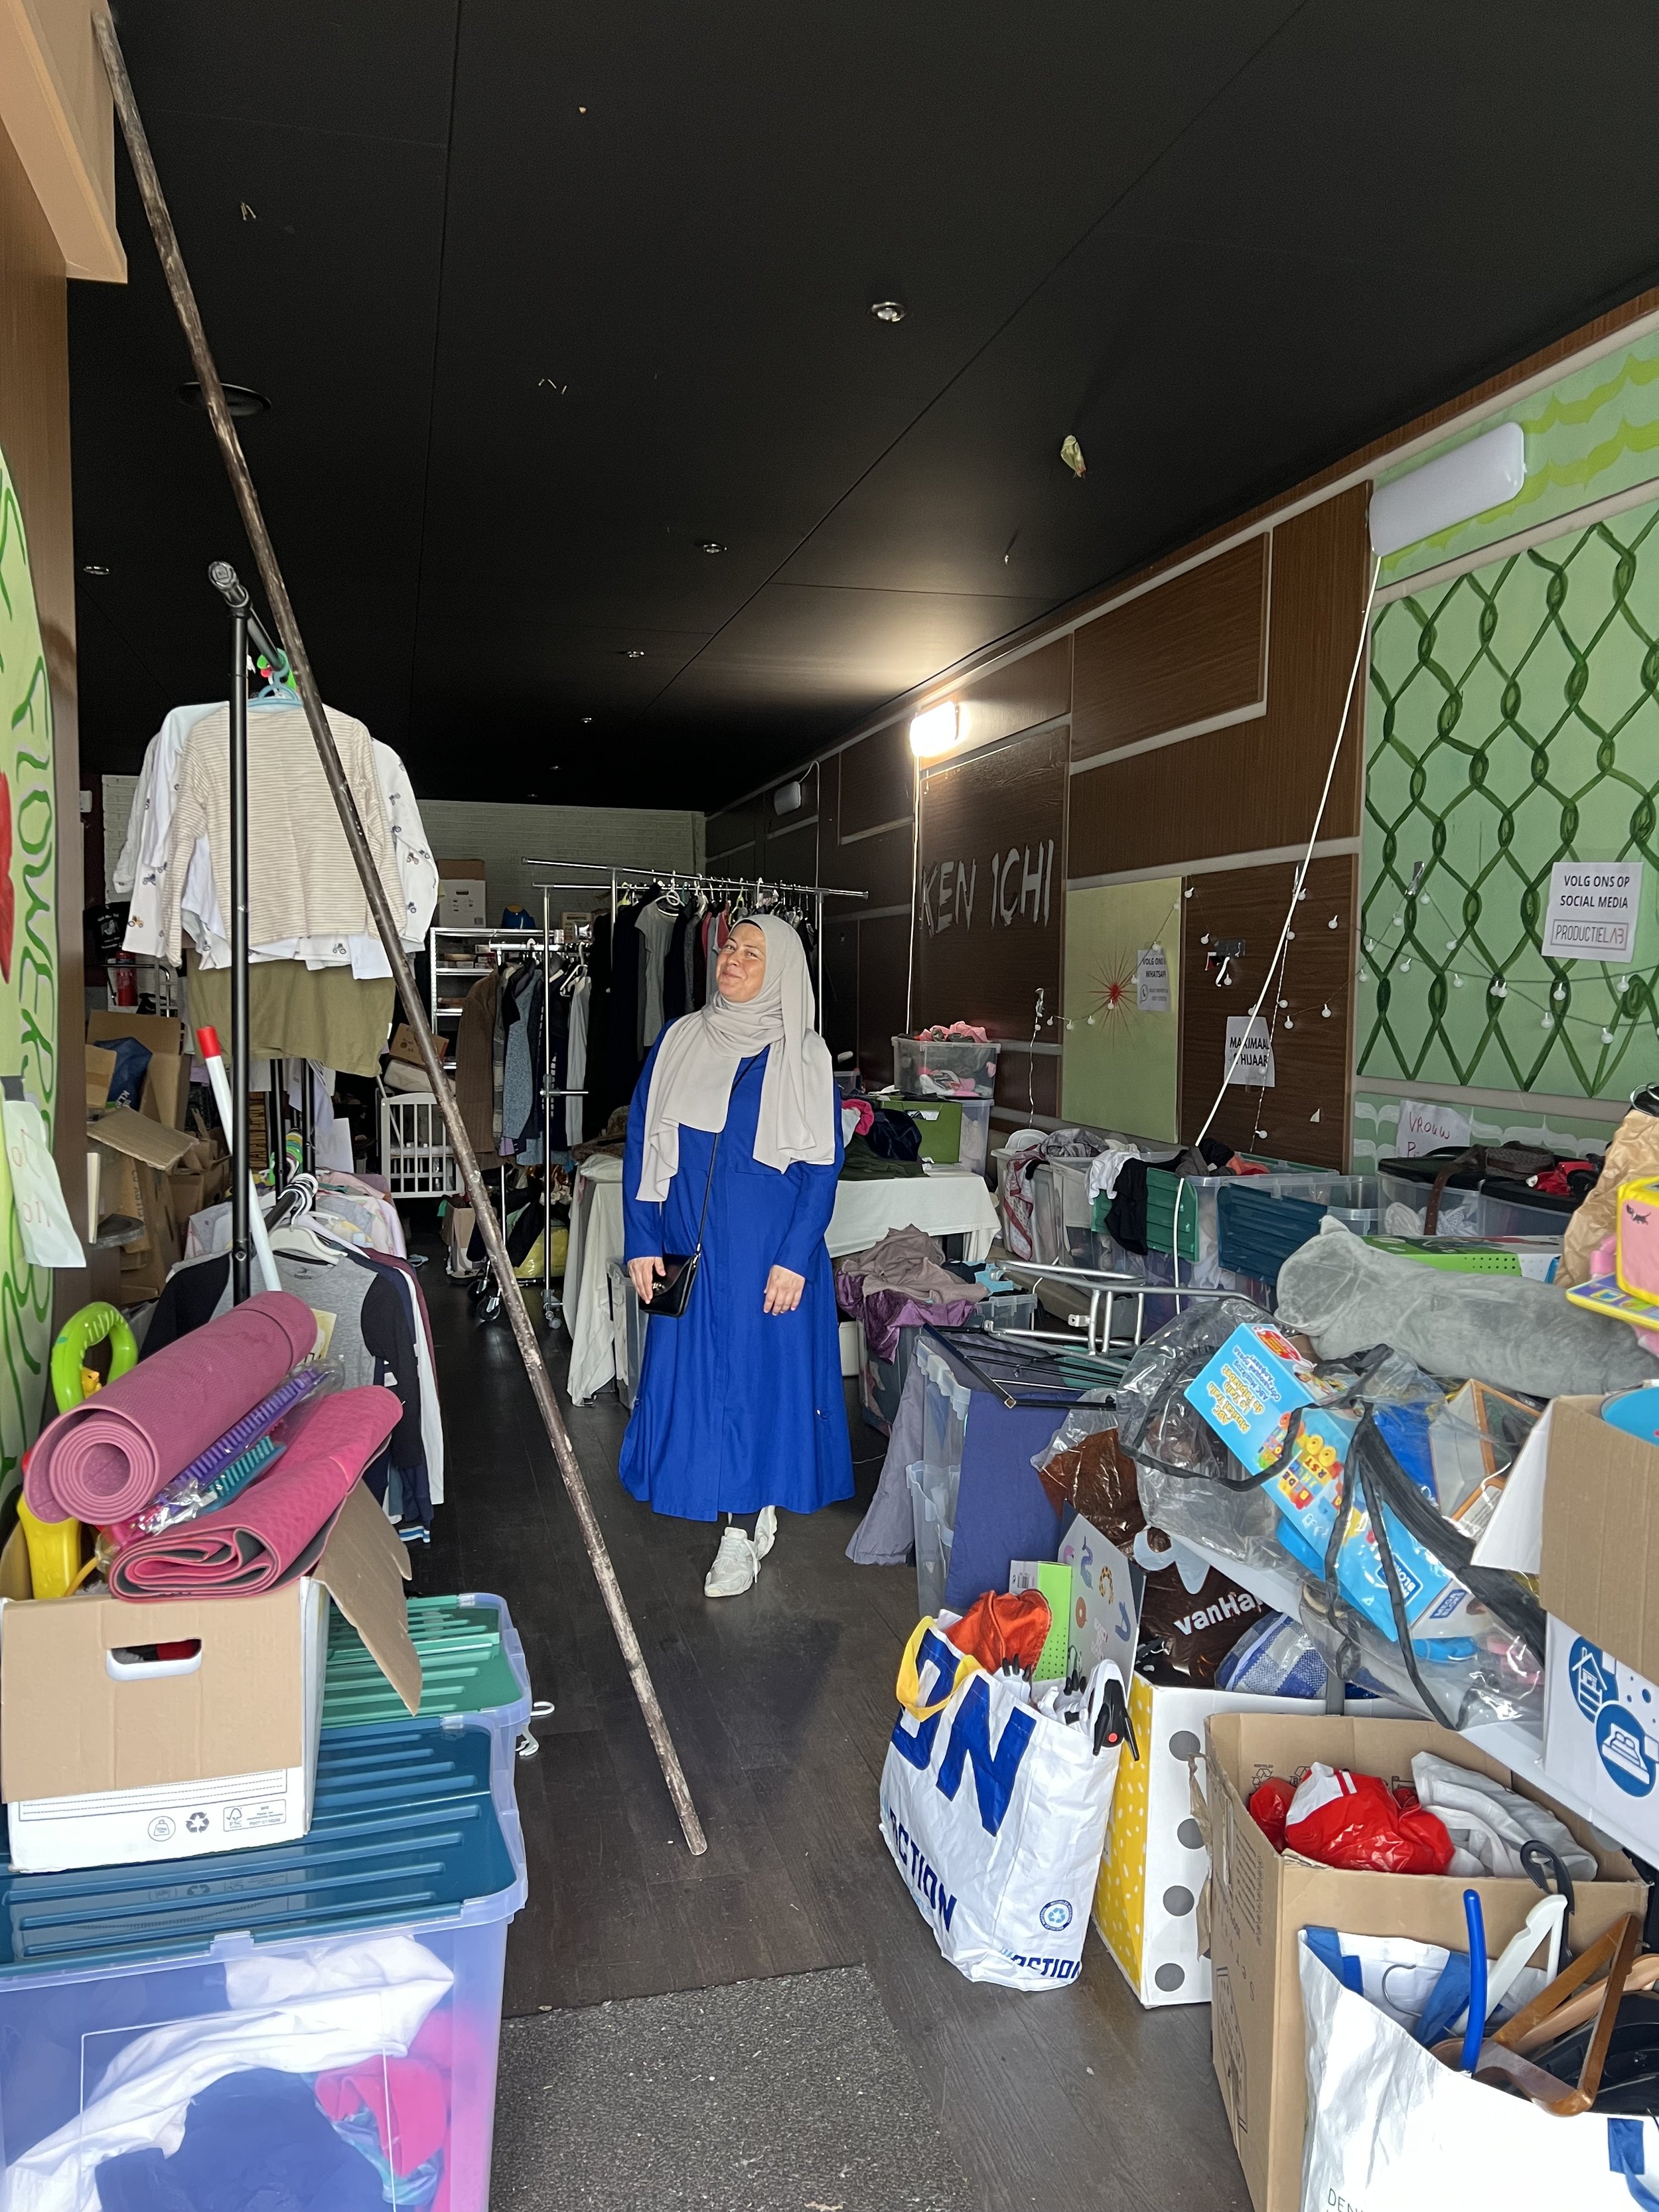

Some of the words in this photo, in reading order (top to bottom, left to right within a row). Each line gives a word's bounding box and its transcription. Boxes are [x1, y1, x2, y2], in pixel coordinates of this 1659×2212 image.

[920, 858, 976, 938] KEN
[991, 839, 1054, 930] ICHI
[1564, 875, 1591, 887] VOLG
[1593, 876, 1615, 887] ONS
[1617, 876, 1630, 888] OP
[1560, 895, 1595, 907] SOCIAL
[1598, 896, 1628, 909] MEDIA
[1208, 1382, 1226, 1406] Train
[1224, 1382, 1240, 1405] Train
[1212, 1404, 1230, 1424] ABC
[1222, 1400, 1250, 1432] Musical
